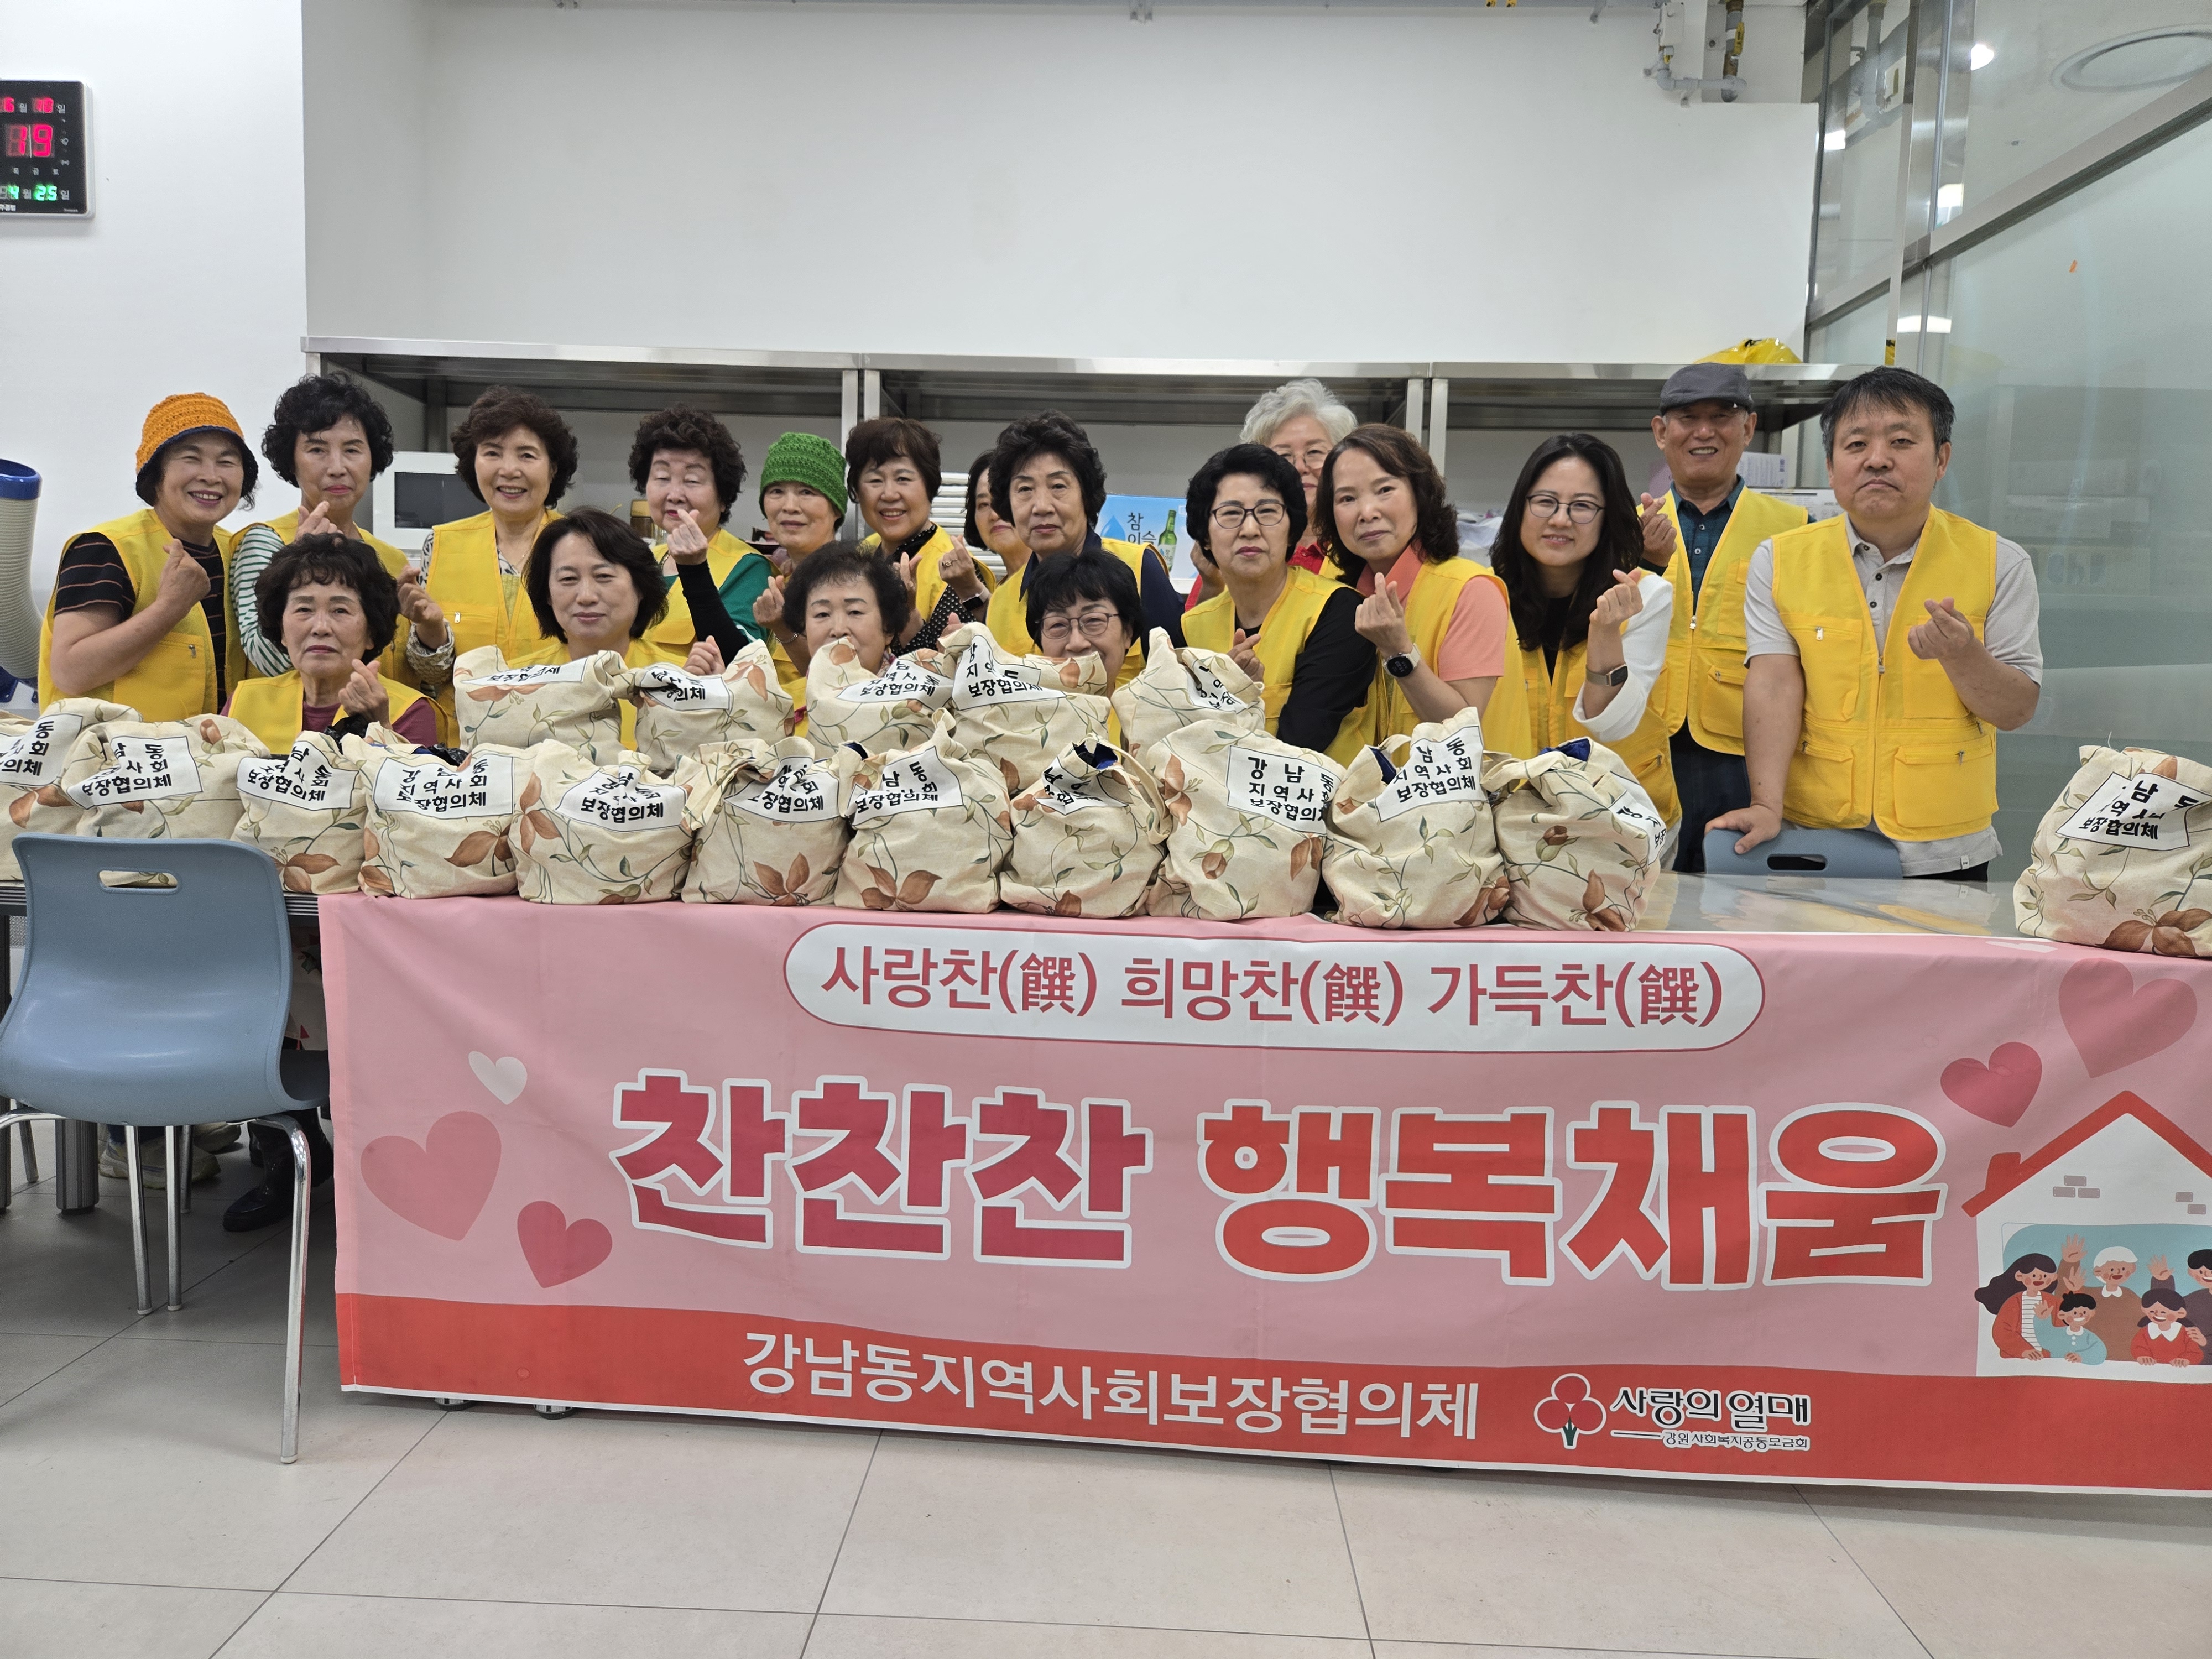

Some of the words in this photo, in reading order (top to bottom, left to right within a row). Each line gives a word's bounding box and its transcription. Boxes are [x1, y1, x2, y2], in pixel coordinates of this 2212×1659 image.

[1127, 512, 1144, 531] 참
[82, 774, 172, 796] 보장협의체
[1396, 775, 1476, 803] 보장협의체
[581, 797, 664, 823] 보장협의체
[609, 1068, 1154, 1270] 찬찬찬
[1196, 1099, 1949, 1292] 행복채움
[743, 1332, 1479, 1440] 강남동지역사회보장협의체
[1611, 1389, 1720, 1426] 사랑의
[1729, 1391, 1808, 1430] 열매
